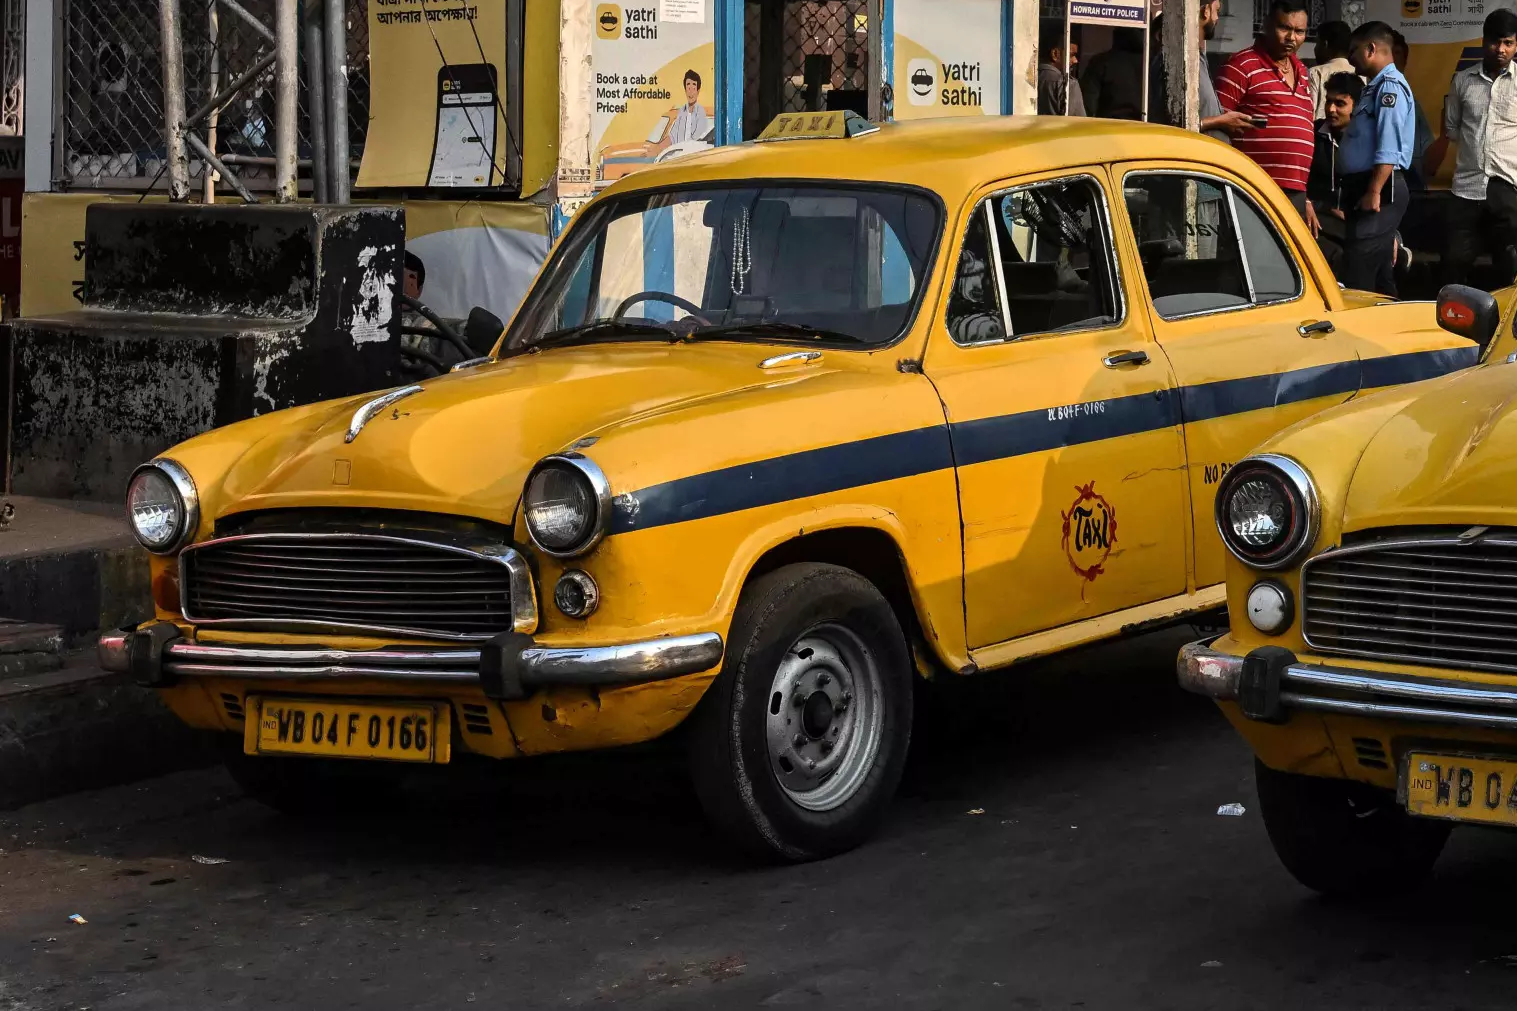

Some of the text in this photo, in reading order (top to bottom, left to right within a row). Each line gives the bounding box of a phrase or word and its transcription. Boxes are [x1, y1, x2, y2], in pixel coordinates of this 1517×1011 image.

[625, 7, 657, 24] yatri
[1072, 5, 1139, 18] HOWRAH CITY POLICE
[1427, 4, 1452, 14] sathi
[377, 10, 422, 25] আপনার
[624, 25, 658, 40] sathi
[596, 73, 658, 85] Book a cab at
[941, 61, 981, 84] yatri
[596, 87, 671, 100] Most Affordable
[941, 86, 982, 106] sathi
[596, 101, 629, 113] Prices!
[778, 114, 837, 133] TAXI
[1204, 464, 1218, 485] NO
[262, 720, 277, 730] IND
[1411, 779, 1432, 790] IND
